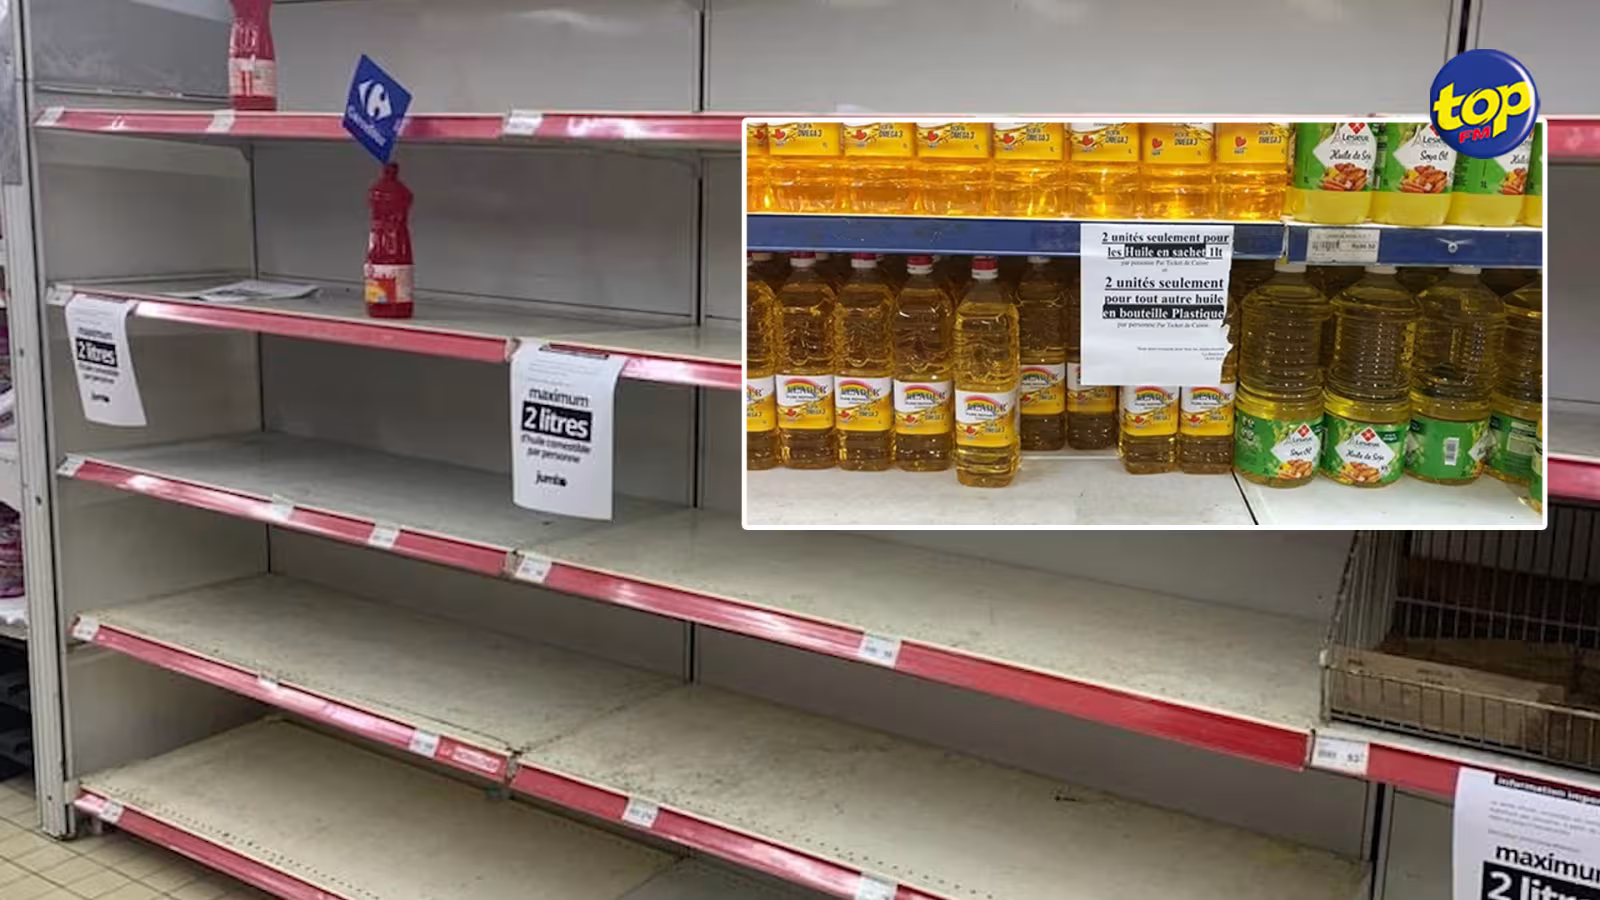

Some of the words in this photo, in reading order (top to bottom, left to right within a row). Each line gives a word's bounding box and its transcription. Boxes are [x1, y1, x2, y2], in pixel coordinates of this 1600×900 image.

[1102, 232, 1108, 242] 2
[1112, 232, 1144, 242] unités
[1146, 232, 1200, 242] seulement
[1204, 234, 1229, 244] pour
[1108, 247, 1122, 258] les
[1125, 247, 1154, 257] Huile
[1173, 247, 1206, 258] sachet
[1105, 277, 1112, 288] 2
[1116, 277, 1155, 288] unités
[1159, 277, 1224, 288] seulement
[1104, 294, 1132, 305] pour
[1135, 295, 1158, 304] tout
[1161, 295, 1192, 304] autre
[1196, 294, 1223, 304] huile
[1102, 310, 1116, 318] en
[1120, 308, 1168, 319] bouteille
[1172, 308, 1224, 320] Plastique
[78, 341, 86, 358] 2
[86, 342, 115, 364] litres
[528, 387, 590, 408] maximum
[524, 406, 537, 430] 2
[539, 407, 589, 438] litres
[542, 450, 580, 463] personne
[1488, 870, 1512, 900] 2
